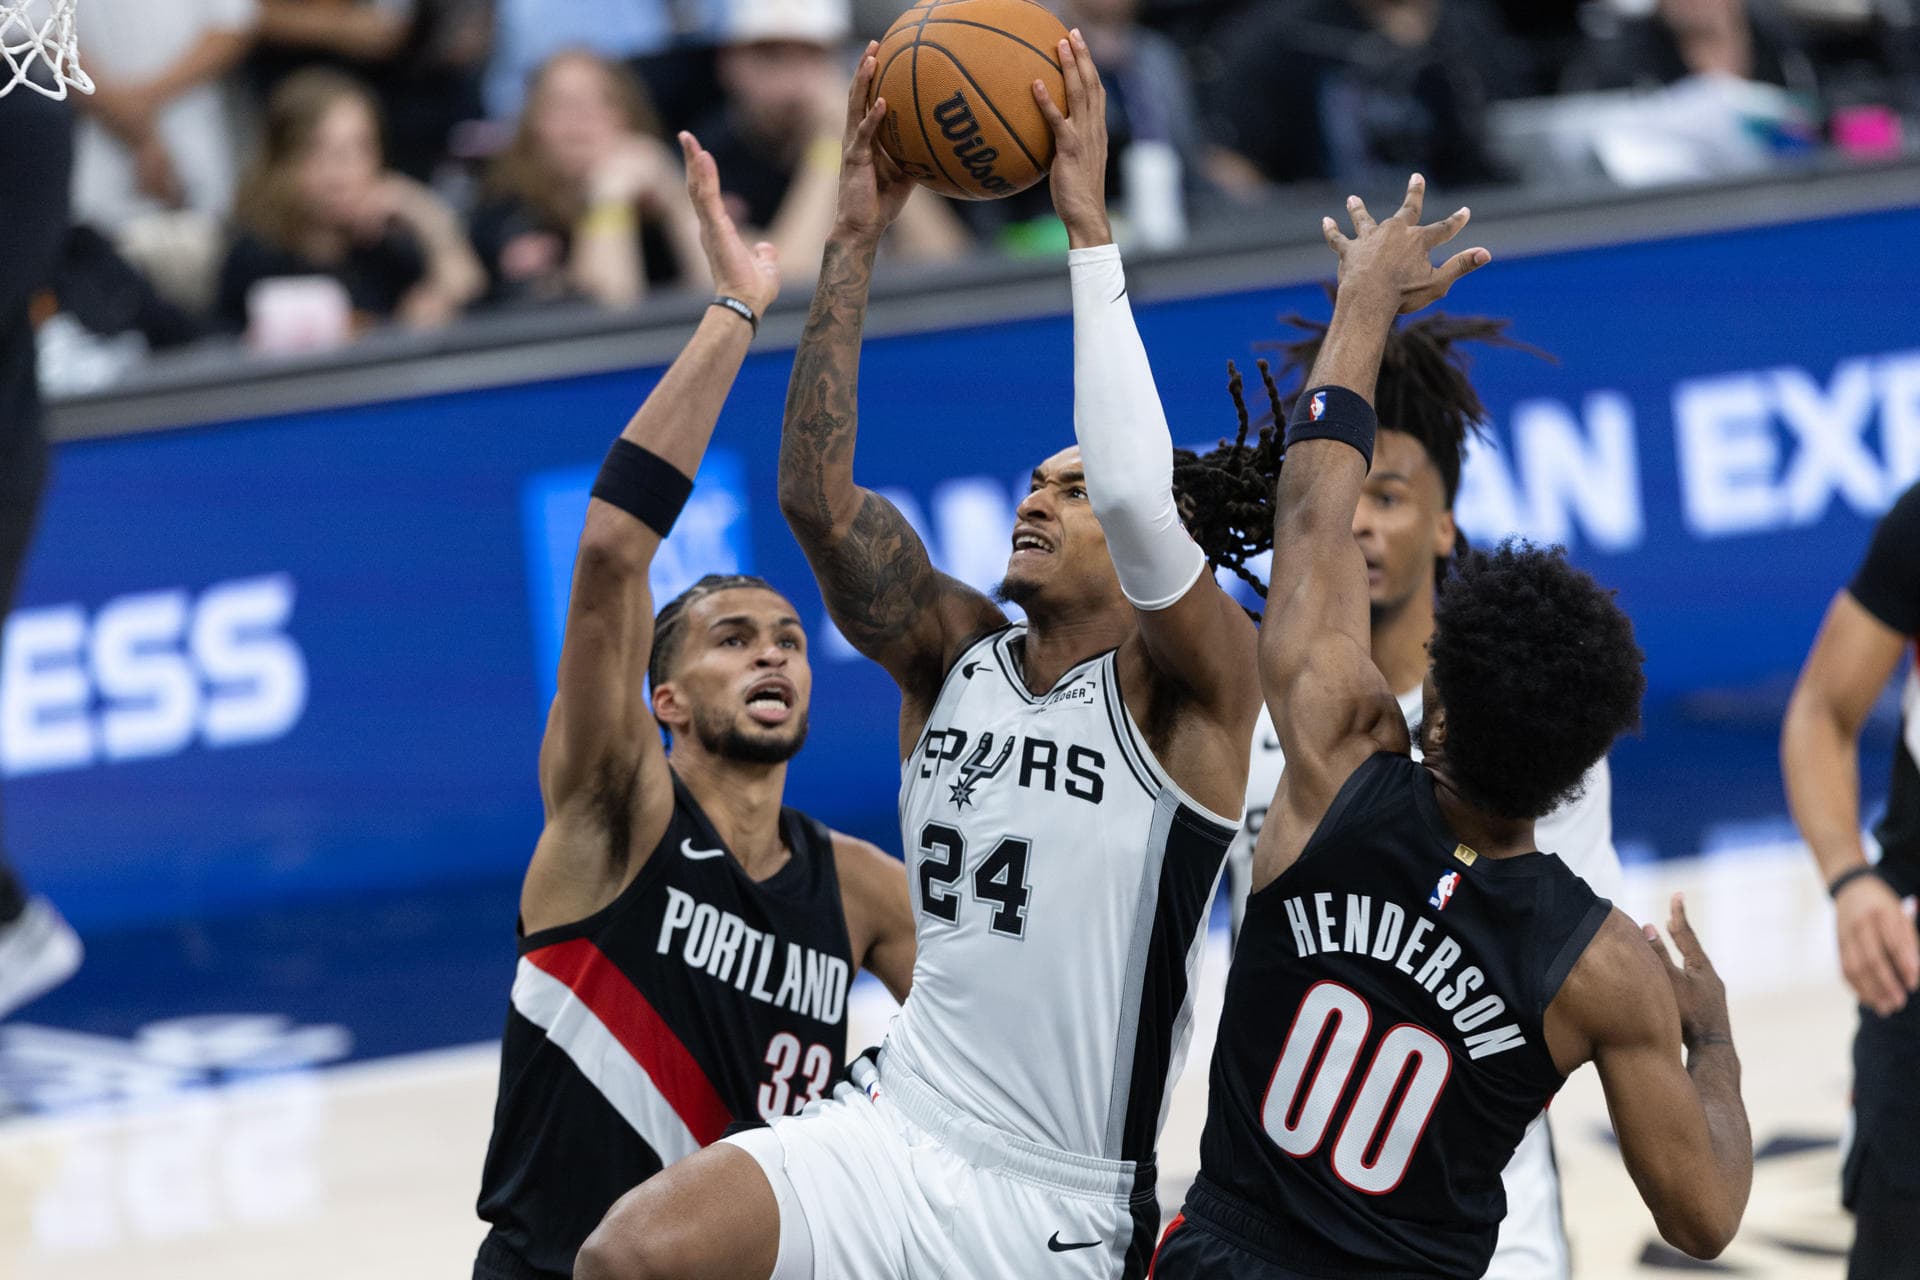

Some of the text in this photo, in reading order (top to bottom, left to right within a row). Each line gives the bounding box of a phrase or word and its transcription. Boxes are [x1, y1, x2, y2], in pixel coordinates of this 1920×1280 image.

[0, 572, 308, 778] ESS
[921, 728, 1106, 812] SPURS
[918, 819, 1033, 942] 24
[656, 885, 849, 1025] PORTLAND
[1283, 891, 1527, 1060] HENDERSON
[757, 1032, 832, 1123] 33
[1259, 979, 1452, 1195] 00
